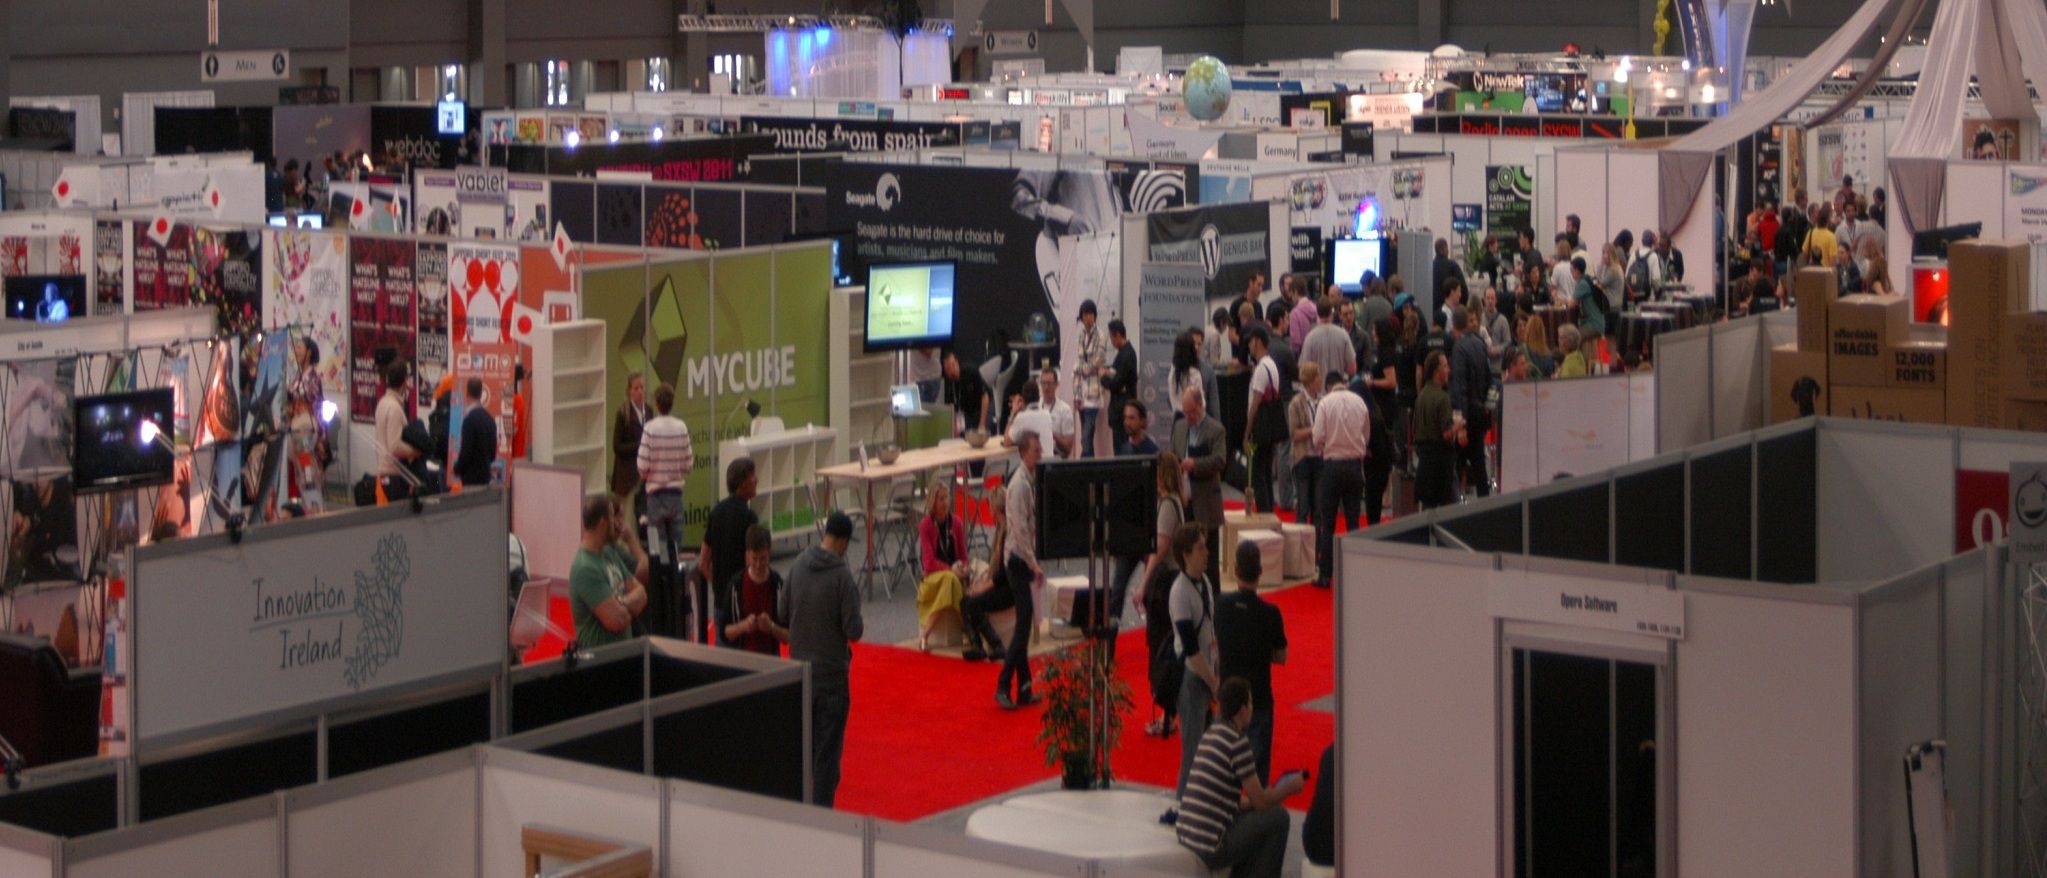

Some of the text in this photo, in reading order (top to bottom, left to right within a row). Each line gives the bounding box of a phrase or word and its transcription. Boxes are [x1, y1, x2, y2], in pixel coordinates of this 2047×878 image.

[1484, 75, 1524, 89] NewTek
[385, 135, 441, 159] webdoc
[1264, 146, 1296, 158] Germany
[846, 190, 876, 208] Seagate
[857, 221, 1006, 244] Seagate is the hard drive of choice for
[1291, 232, 1310, 245] with
[928, 246, 944, 260] and
[1834, 328, 1878, 340] affordable
[1834, 342, 1878, 356] IMAGES
[1896, 351, 1936, 367] 12,000
[687, 344, 796, 400] MYCUBE
[1896, 369, 1936, 383] FONTS
[252, 576, 346, 622] Innovation
[1560, 592, 1618, 613] Opera Software
[280, 621, 343, 670] Ireland
